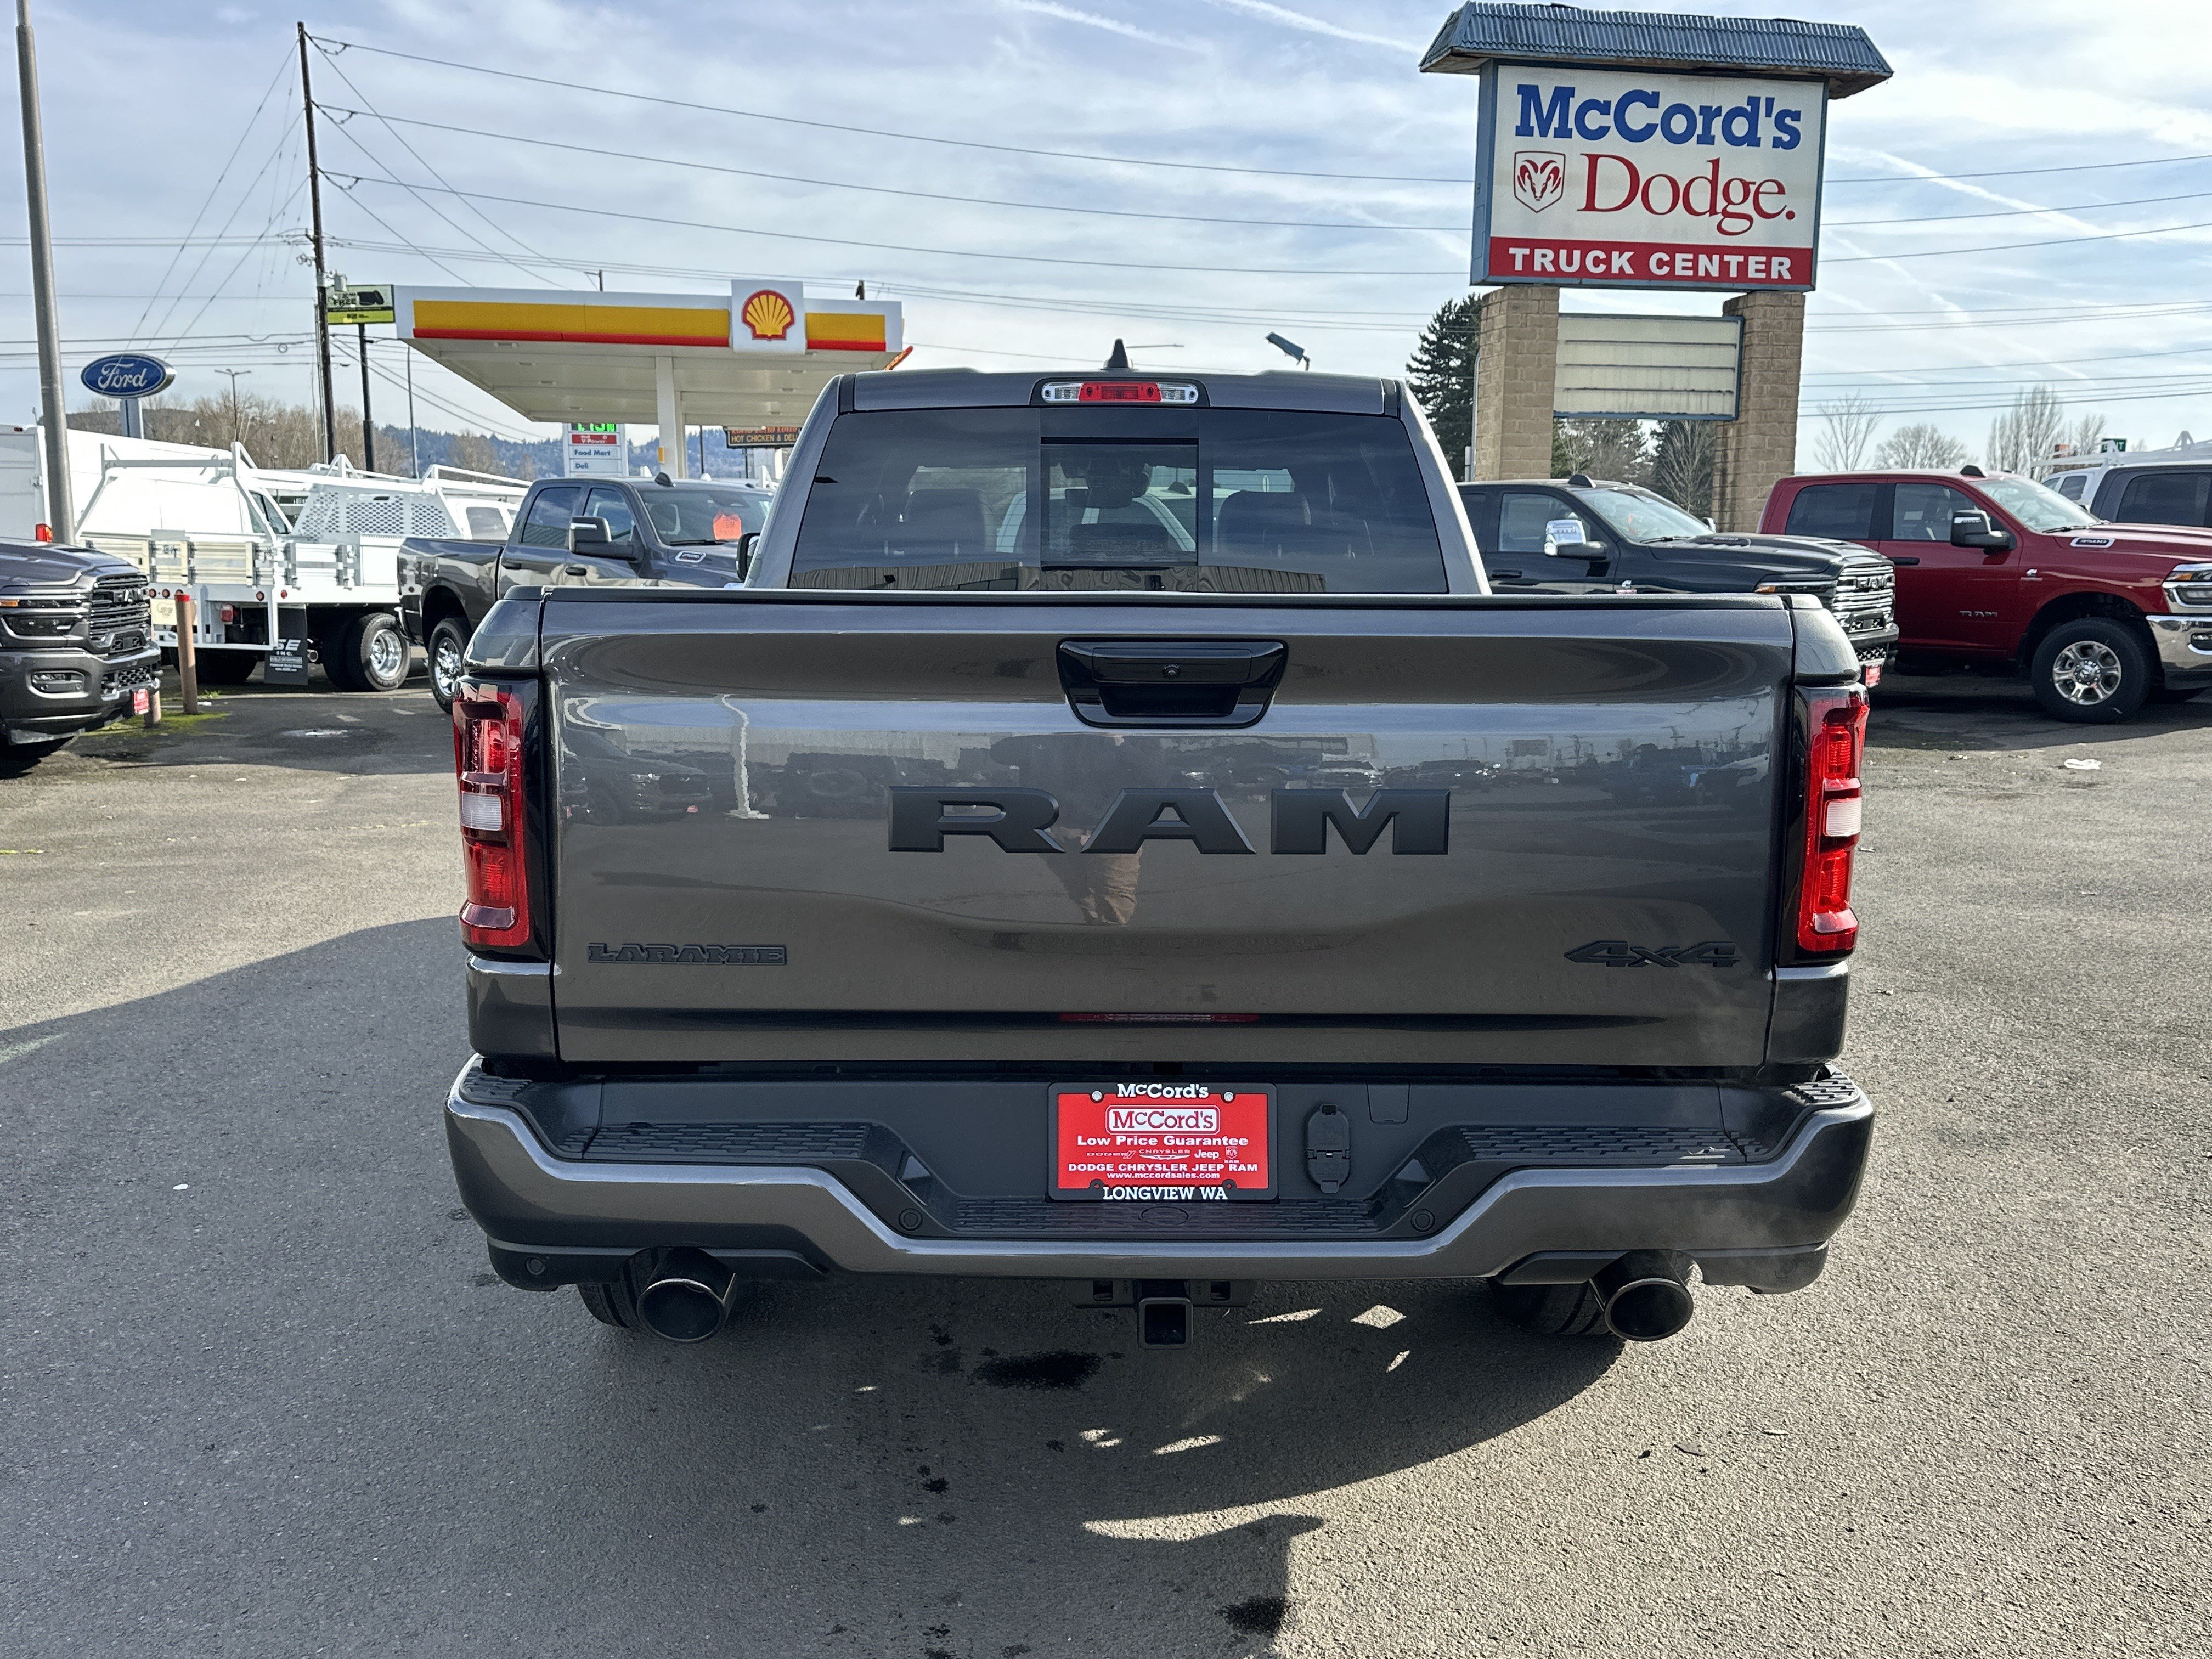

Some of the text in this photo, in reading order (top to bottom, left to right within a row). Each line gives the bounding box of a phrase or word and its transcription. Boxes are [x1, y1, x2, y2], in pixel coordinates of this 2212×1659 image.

[1515, 84, 1802, 150] McCord's
[1576, 153, 1796, 236] Dodge.
[1509, 247, 1792, 280] TRUCK CENTER
[98, 363, 148, 388] Ford
[746, 434, 775, 442] CHICKEN
[889, 786, 1451, 855] RAM
[588, 943, 787, 965] LARAMIE
[1117, 1084, 1209, 1098] McCord's
[1113, 1111, 1214, 1129] McCord's
[1077, 1135, 1248, 1146] Low Price Guarantee
[1194, 1149, 1220, 1160] Jeep
[1192, 1164, 1224, 1172] JEEP
[1103, 1187, 1228, 1200] LONGVIEW WA
